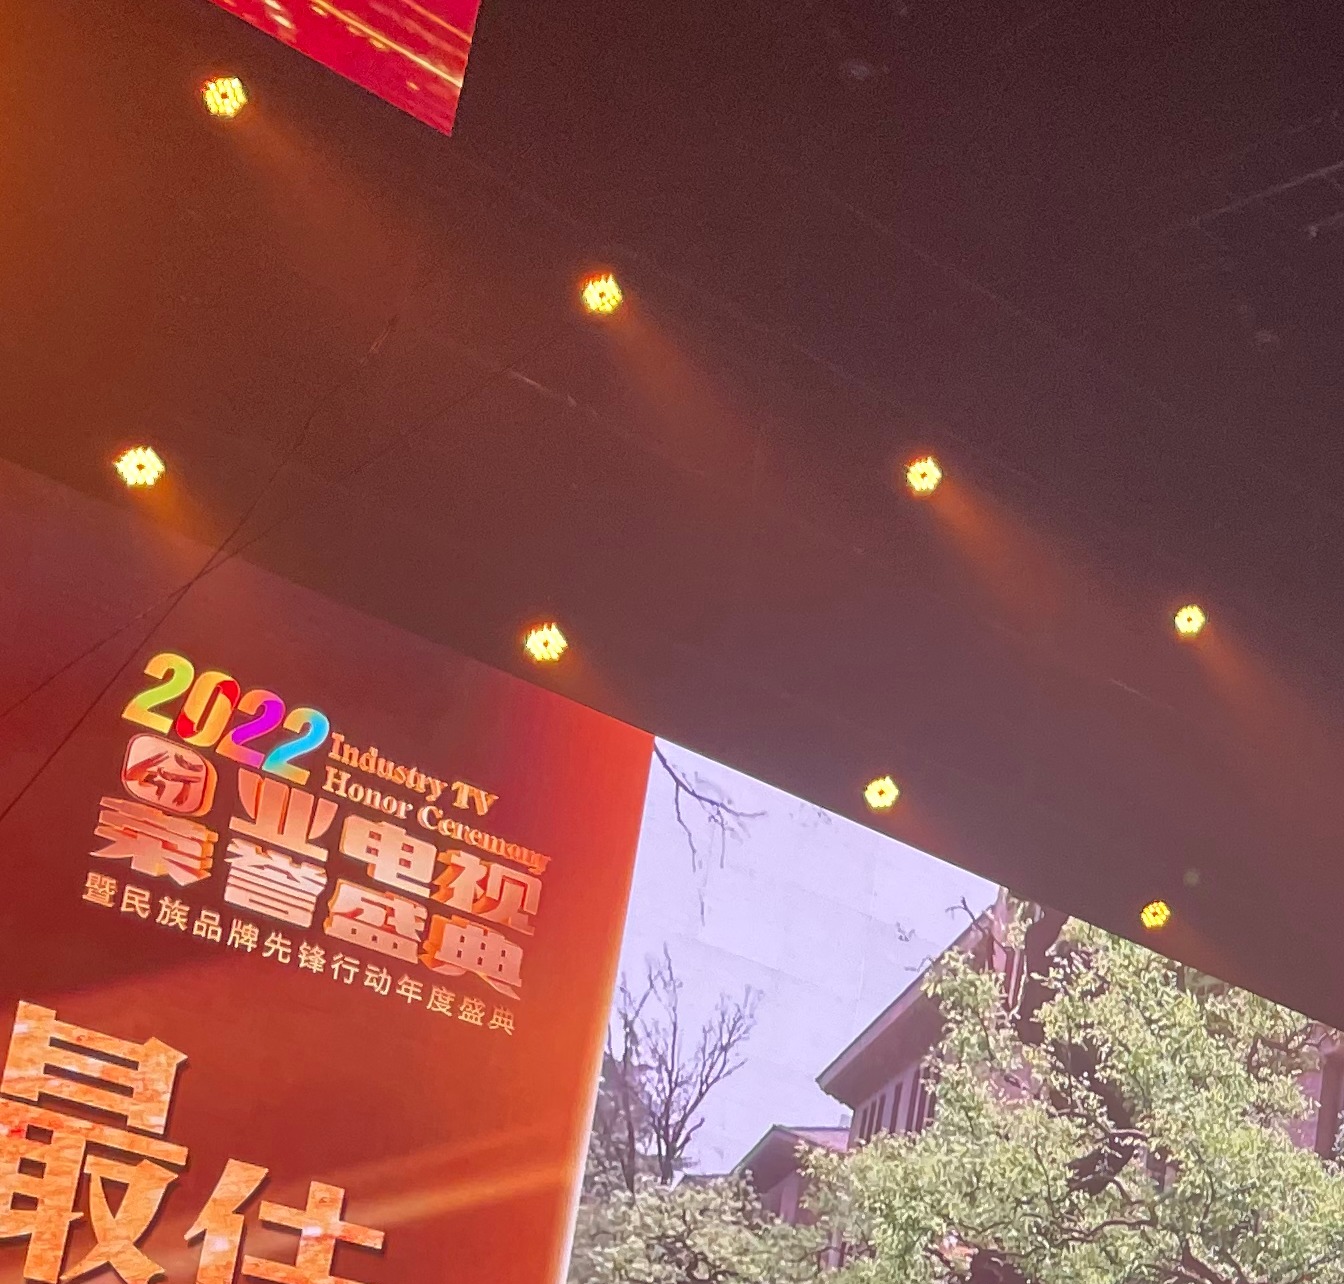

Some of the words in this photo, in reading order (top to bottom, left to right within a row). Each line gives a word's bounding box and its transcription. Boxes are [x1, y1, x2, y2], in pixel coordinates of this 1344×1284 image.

[121, 652, 330, 786] 2022
[328, 732, 448, 801] Industry
[451, 781, 500, 816] TV
[322, 765, 413, 819] Honor
[417, 805, 552, 875] Ceremony
[82, 871, 517, 1036] 暨民族品牌先锋行动年度盛典
[90, 797, 523, 1000] 荣誉盛典
